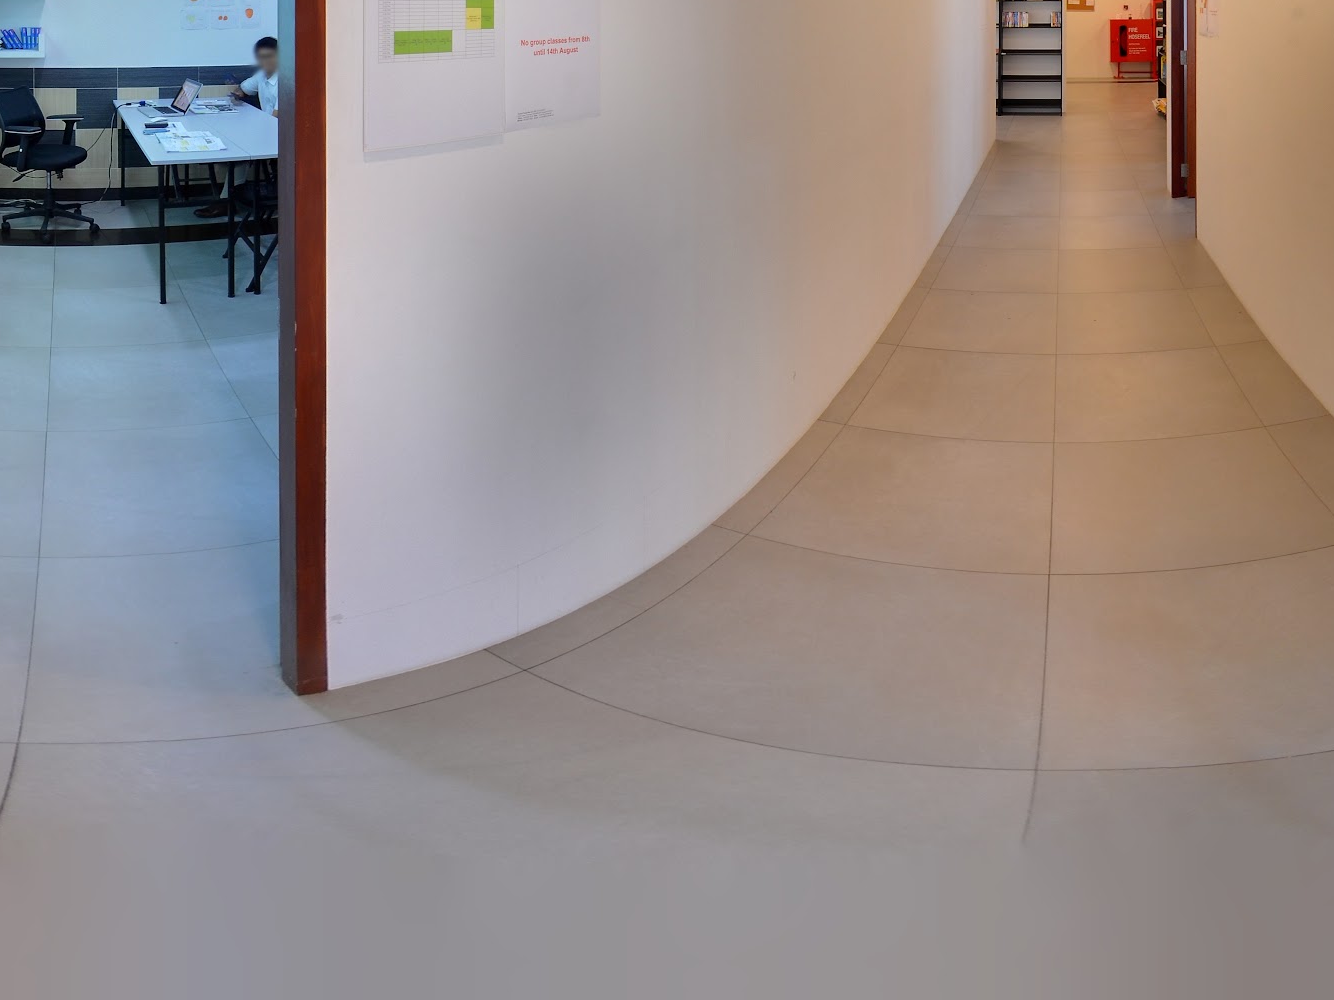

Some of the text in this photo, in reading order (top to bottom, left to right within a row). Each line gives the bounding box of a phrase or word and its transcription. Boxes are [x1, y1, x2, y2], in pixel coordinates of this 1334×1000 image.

[530, 38, 546, 47] group
[547, 36, 567, 45] classes
[559, 47, 578, 55] August
